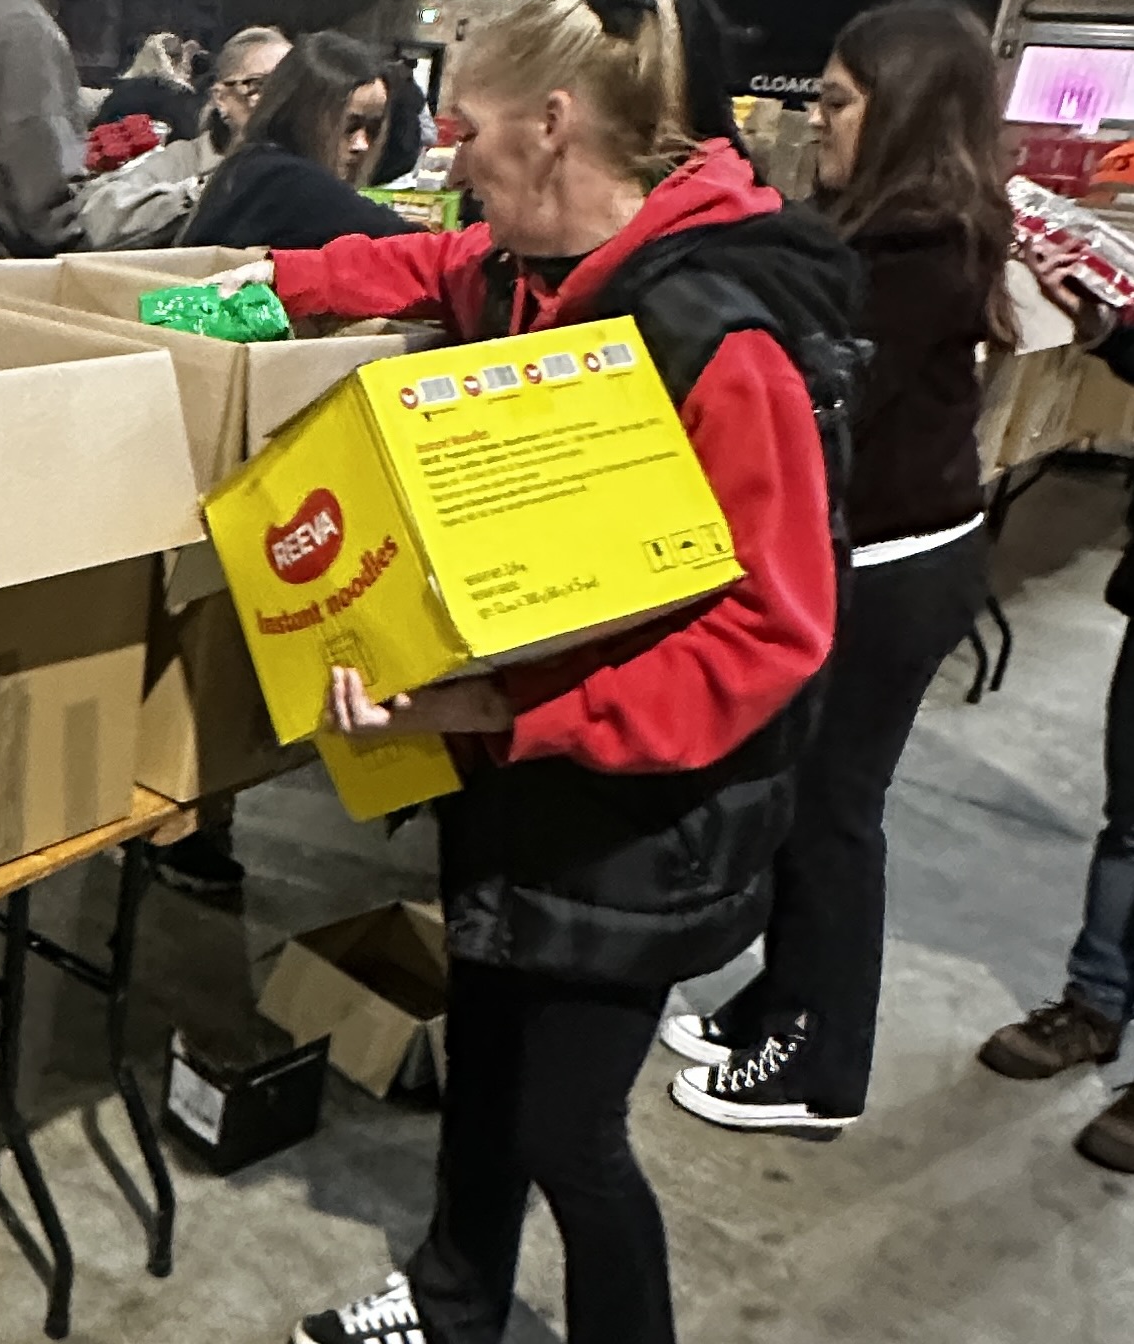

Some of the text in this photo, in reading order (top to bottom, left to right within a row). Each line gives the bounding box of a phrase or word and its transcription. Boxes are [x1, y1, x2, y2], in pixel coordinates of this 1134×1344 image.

[750, 75, 822, 93] CLOAKR
[271, 510, 339, 571] REEVA
[324, 535, 399, 614] noodles
